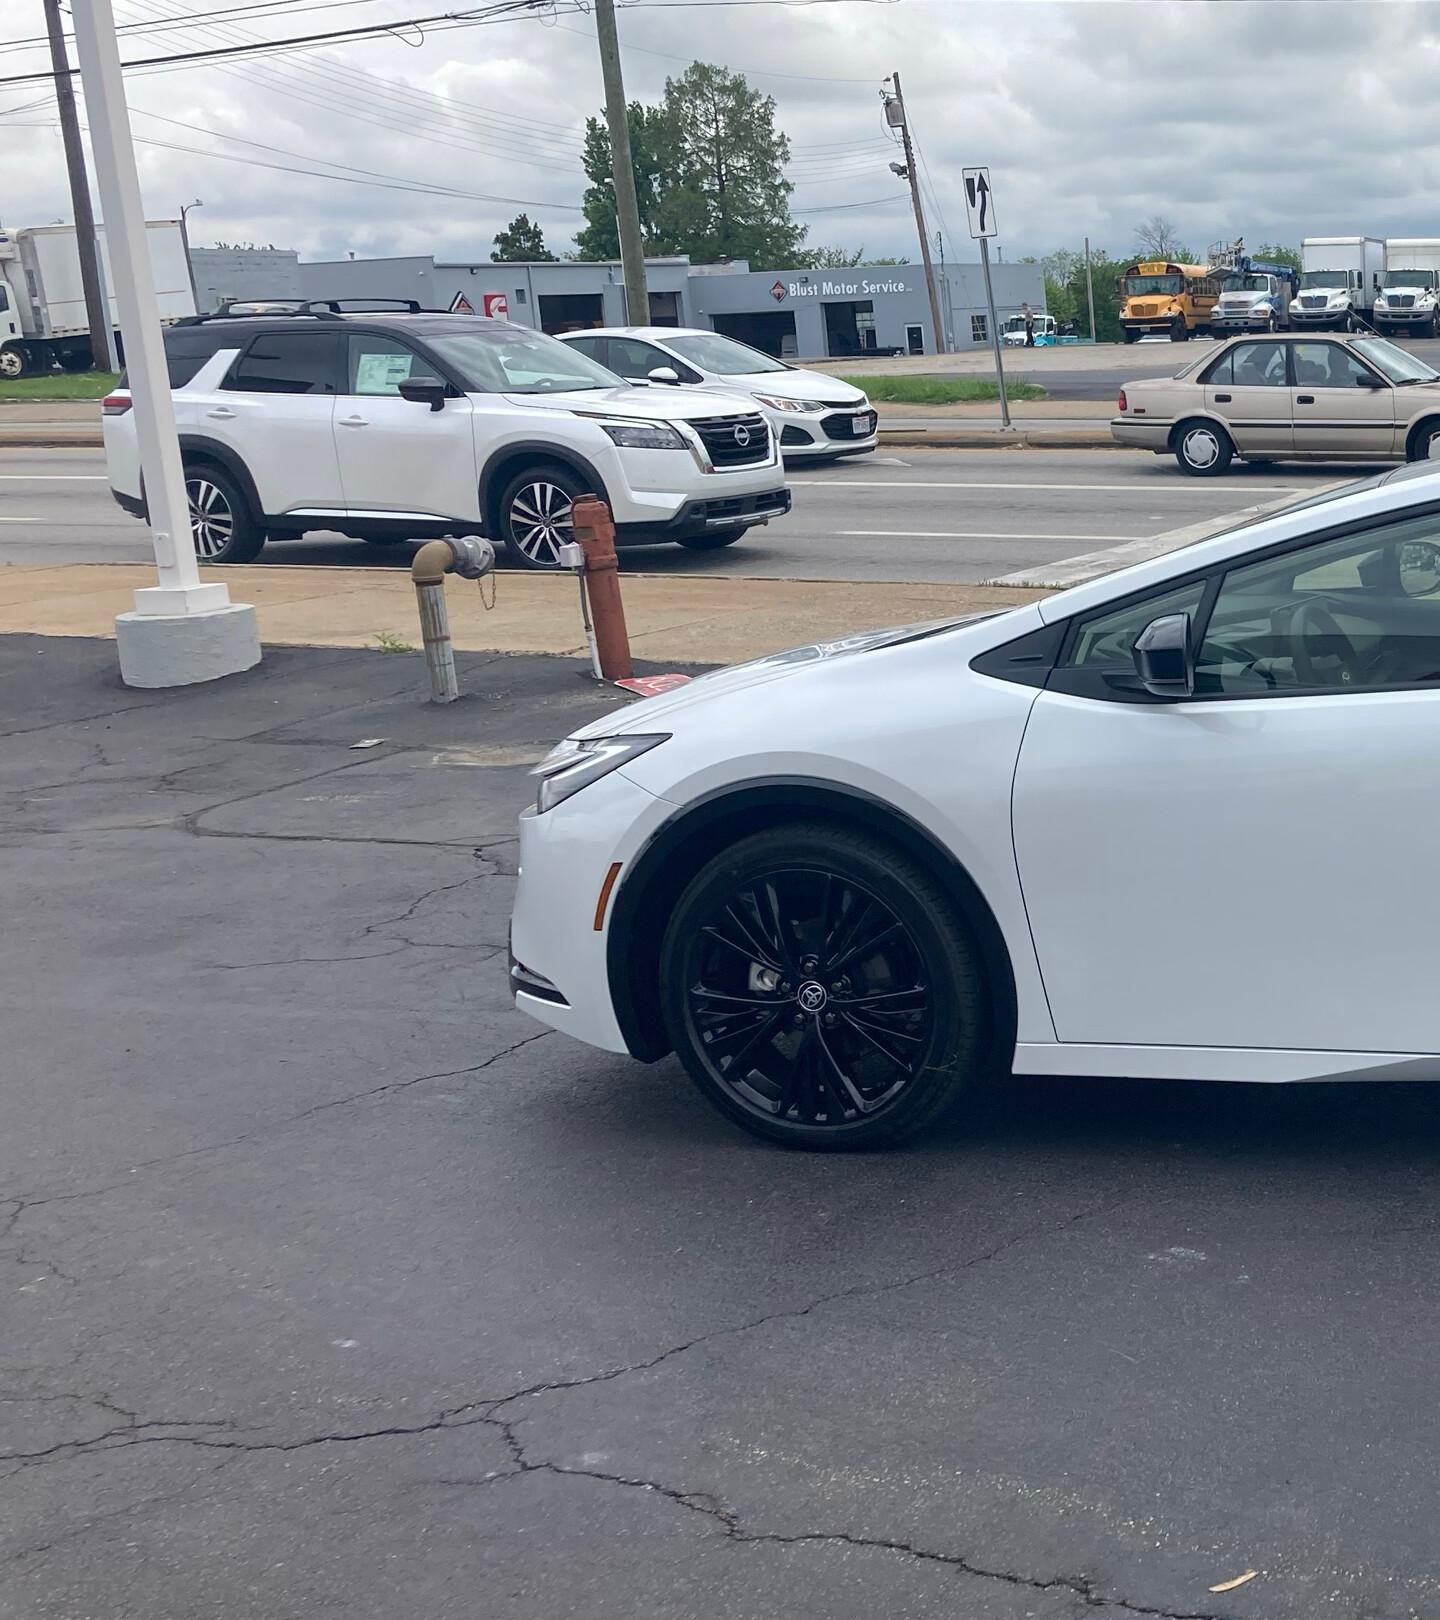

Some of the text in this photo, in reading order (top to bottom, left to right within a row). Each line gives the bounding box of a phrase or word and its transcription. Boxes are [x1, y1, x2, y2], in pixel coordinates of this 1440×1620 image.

[789, 280, 905, 297] Blust Motor Service
